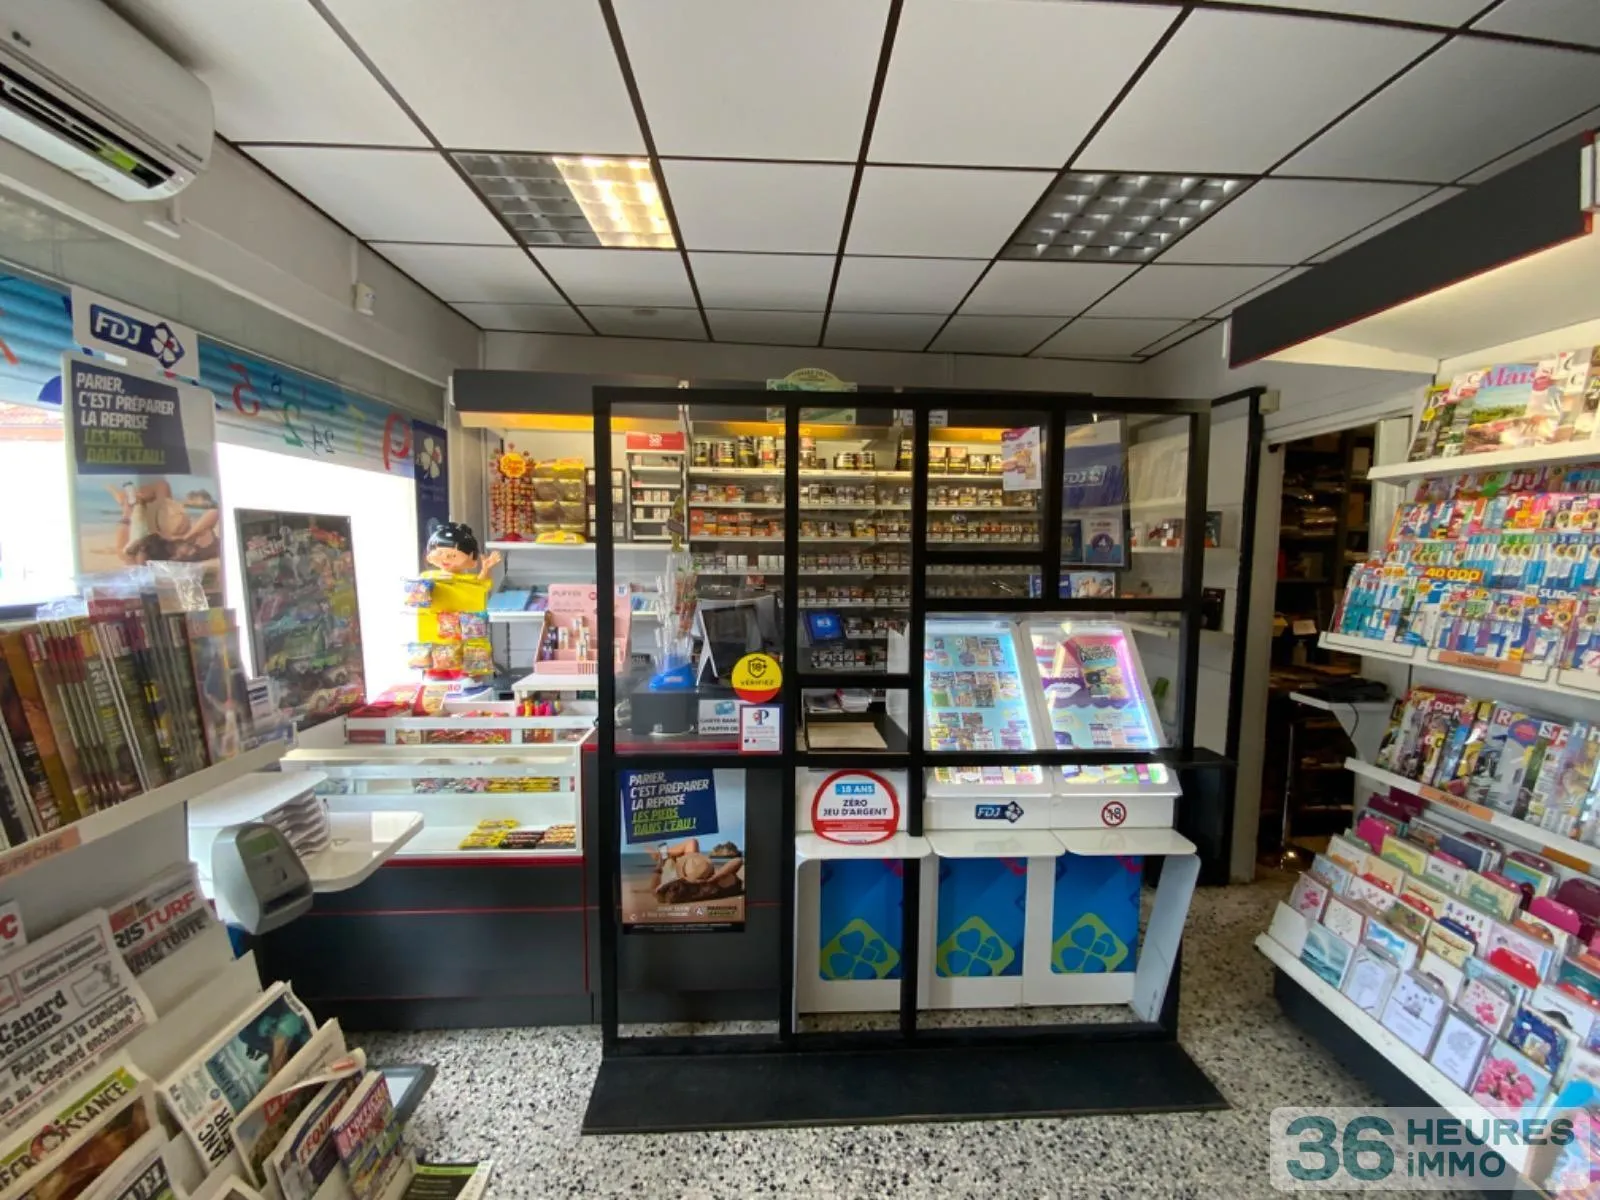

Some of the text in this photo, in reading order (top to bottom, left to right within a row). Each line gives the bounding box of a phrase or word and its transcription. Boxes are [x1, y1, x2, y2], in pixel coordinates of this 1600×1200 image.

[95, 312, 143, 346] FDJ
[76, 372, 126, 394] PARIER,
[78, 391, 176, 416] C'EST PRÉPARER
[81, 410, 149, 429] LA REPRISE
[629, 772, 666, 786] PARIER,
[630, 785, 657, 798] C'EST
[853, 785, 874, 793] ANS
[631, 794, 686, 810] LA REPRISE
[842, 797, 868, 807] ZÉRO
[632, 807, 680, 823] LES PIEDS
[823, 808, 888, 816] JEU D'ARGENT
[976, 807, 1001, 818] FDJ
[633, 822, 662, 836] DANS
[0, 989, 68, 1044] Canard
[11, 1050, 51, 1081] Plutôt
[73, 1023, 89, 1038] la
[15, 1084, 32, 1102] au
